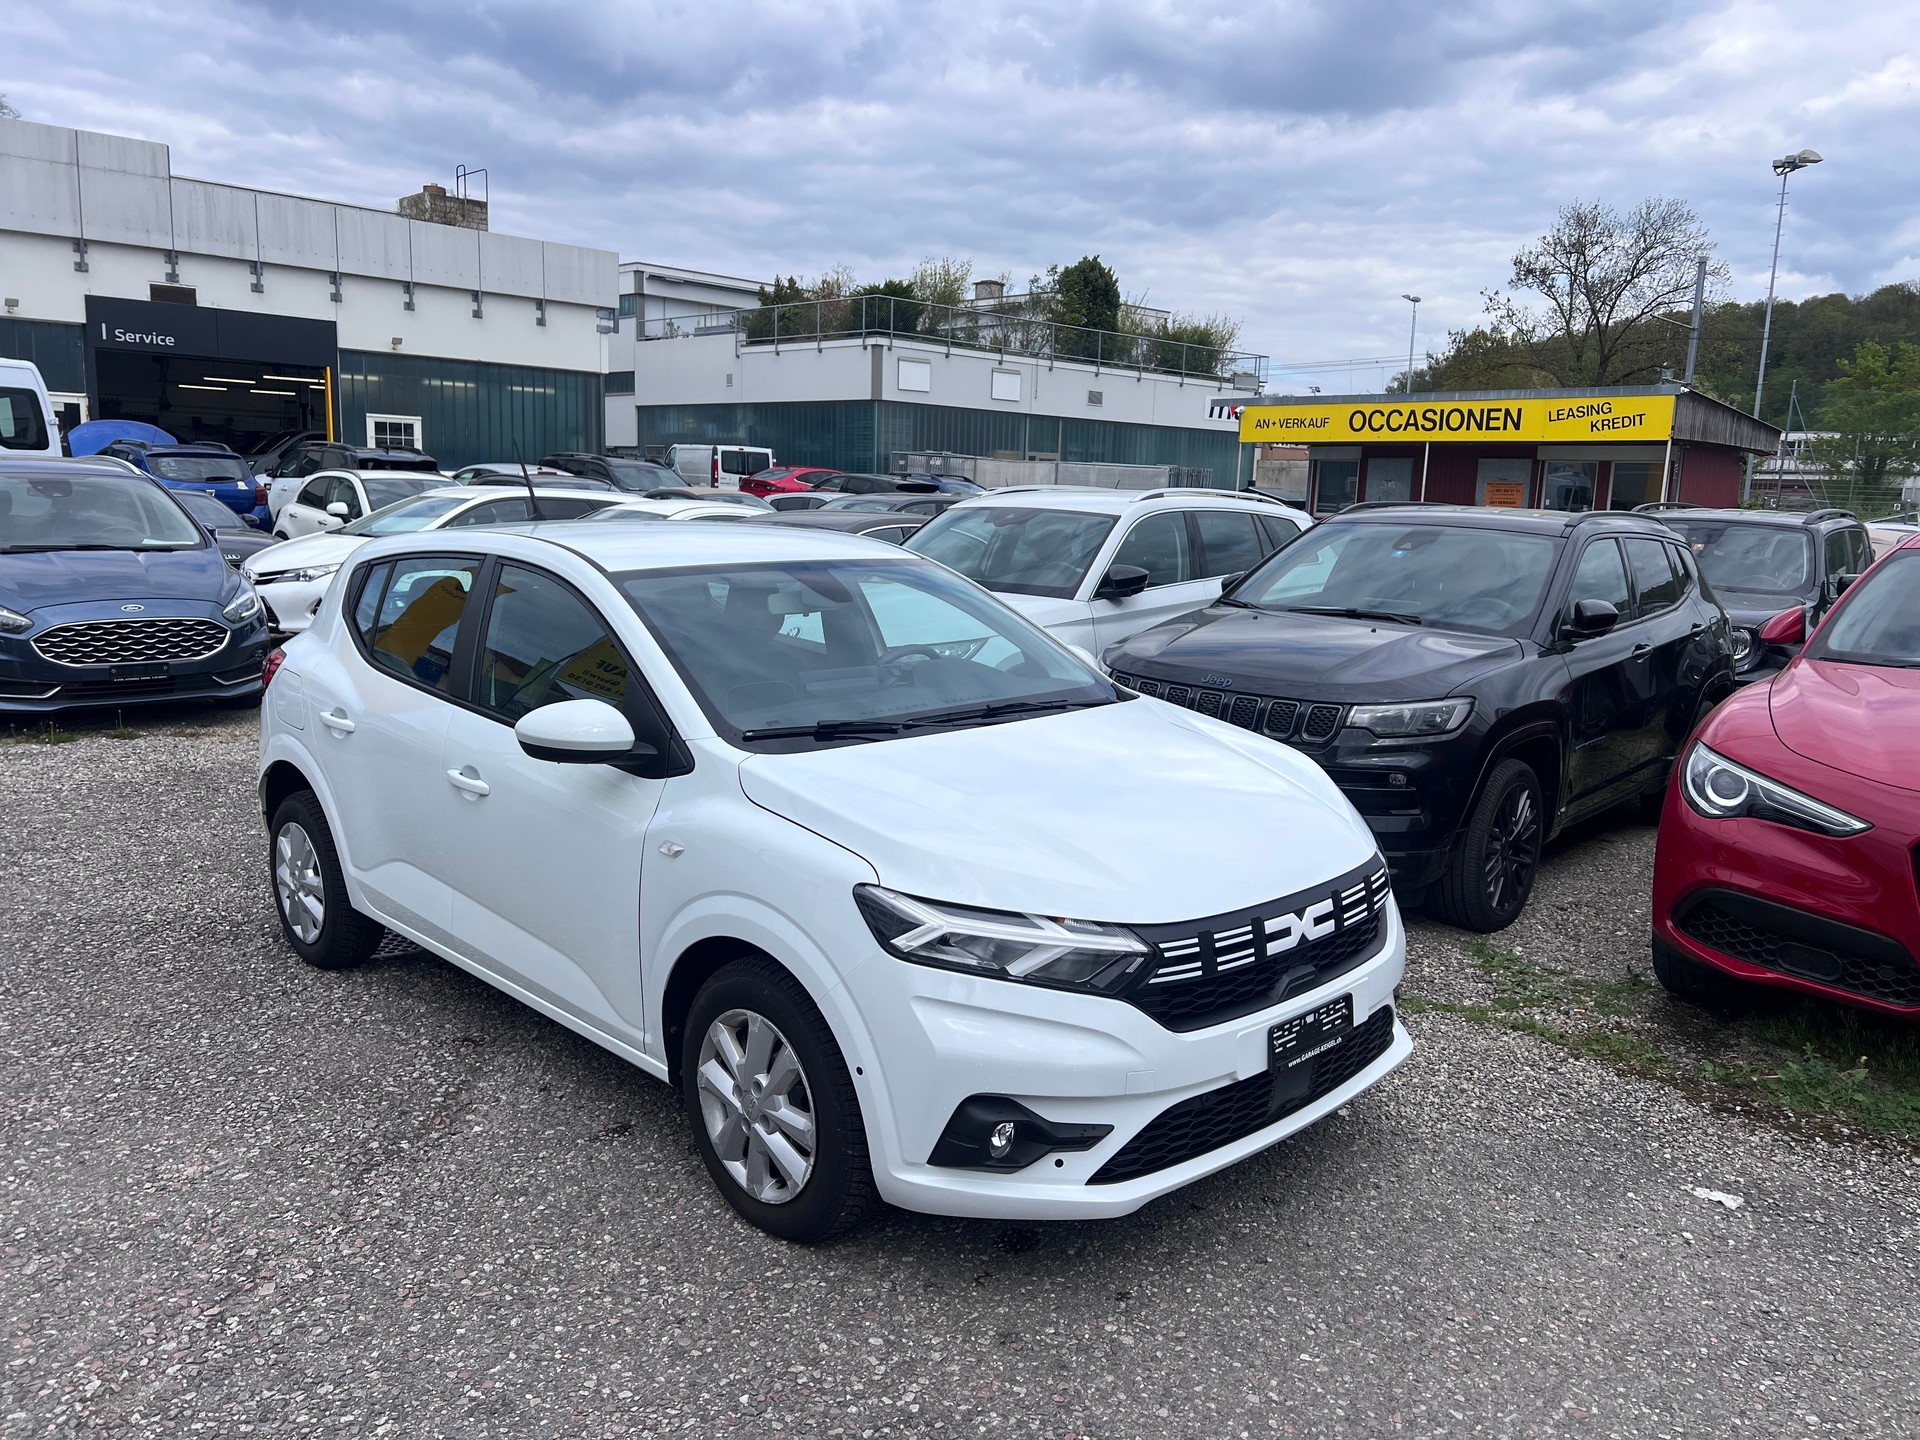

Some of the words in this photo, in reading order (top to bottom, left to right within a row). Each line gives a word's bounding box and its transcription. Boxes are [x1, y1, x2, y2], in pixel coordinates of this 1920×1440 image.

[114, 328, 175, 346] Service
[1349, 407, 1522, 432] OCCASIONEN
[1548, 401, 1612, 422] LEASING
[1590, 413, 1646, 432] KREDIT
[1200, 673, 1233, 688] Jeep
